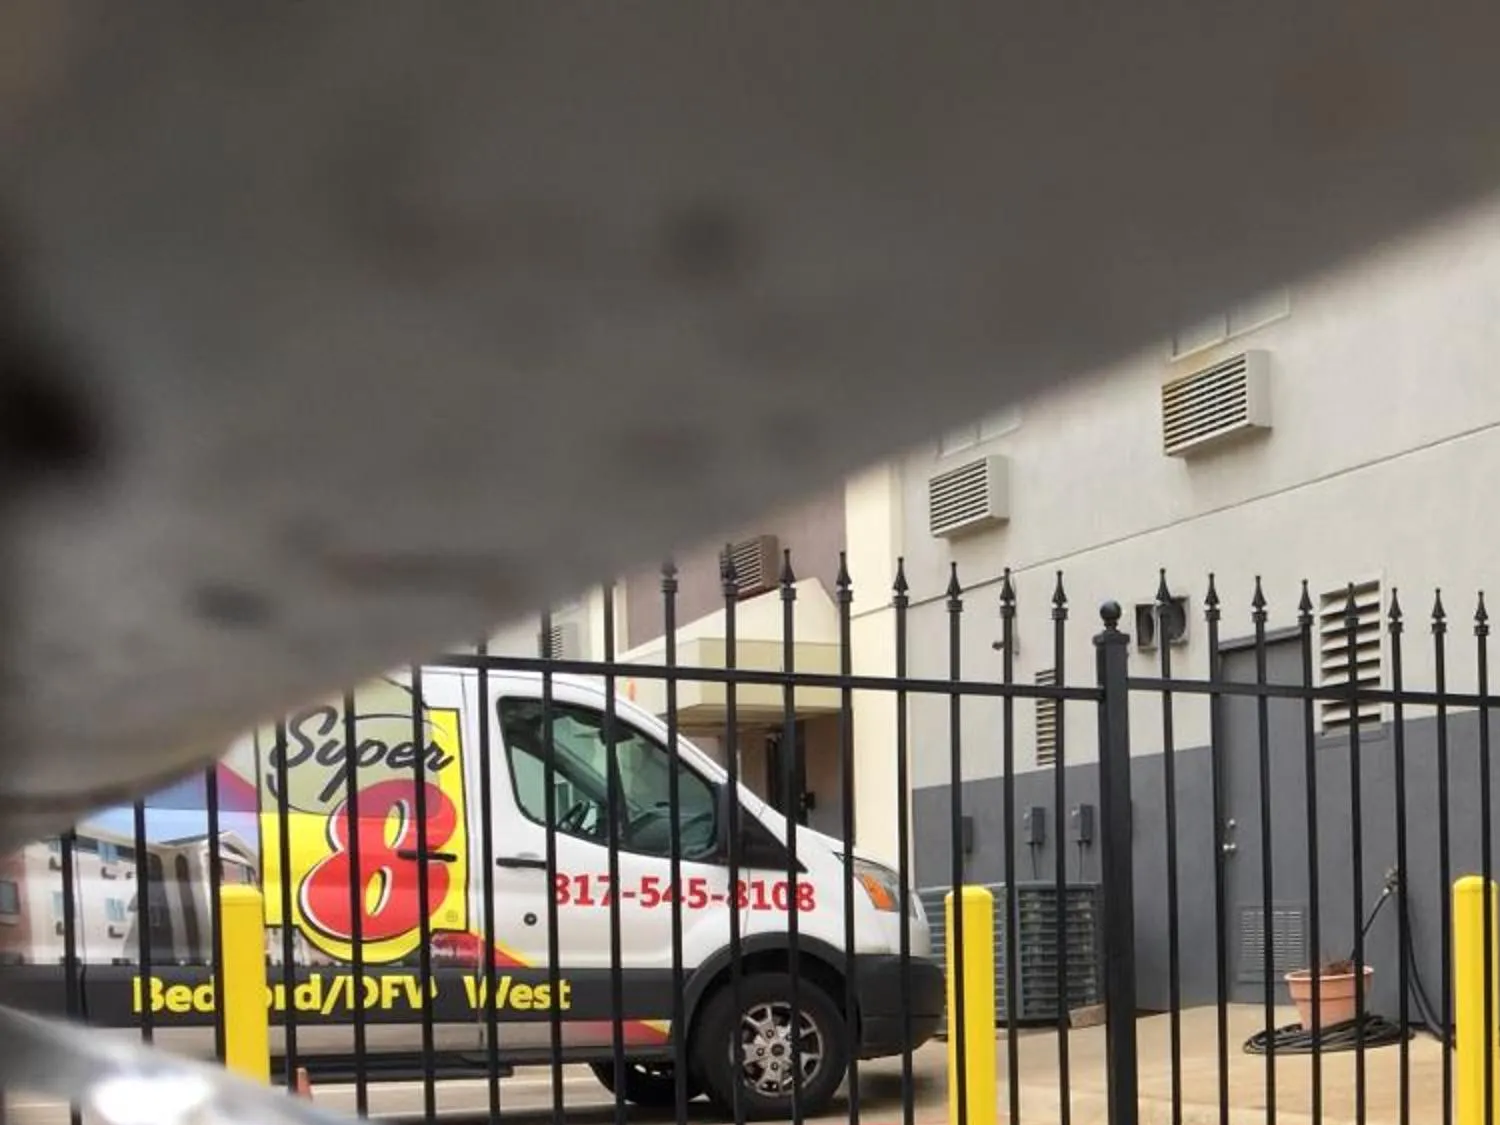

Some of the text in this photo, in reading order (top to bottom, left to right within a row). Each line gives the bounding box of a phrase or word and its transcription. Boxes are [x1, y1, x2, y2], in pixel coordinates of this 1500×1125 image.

[266, 705, 454, 802] Super
[298, 777, 458, 945] 8
[463, 975, 571, 1010] West
